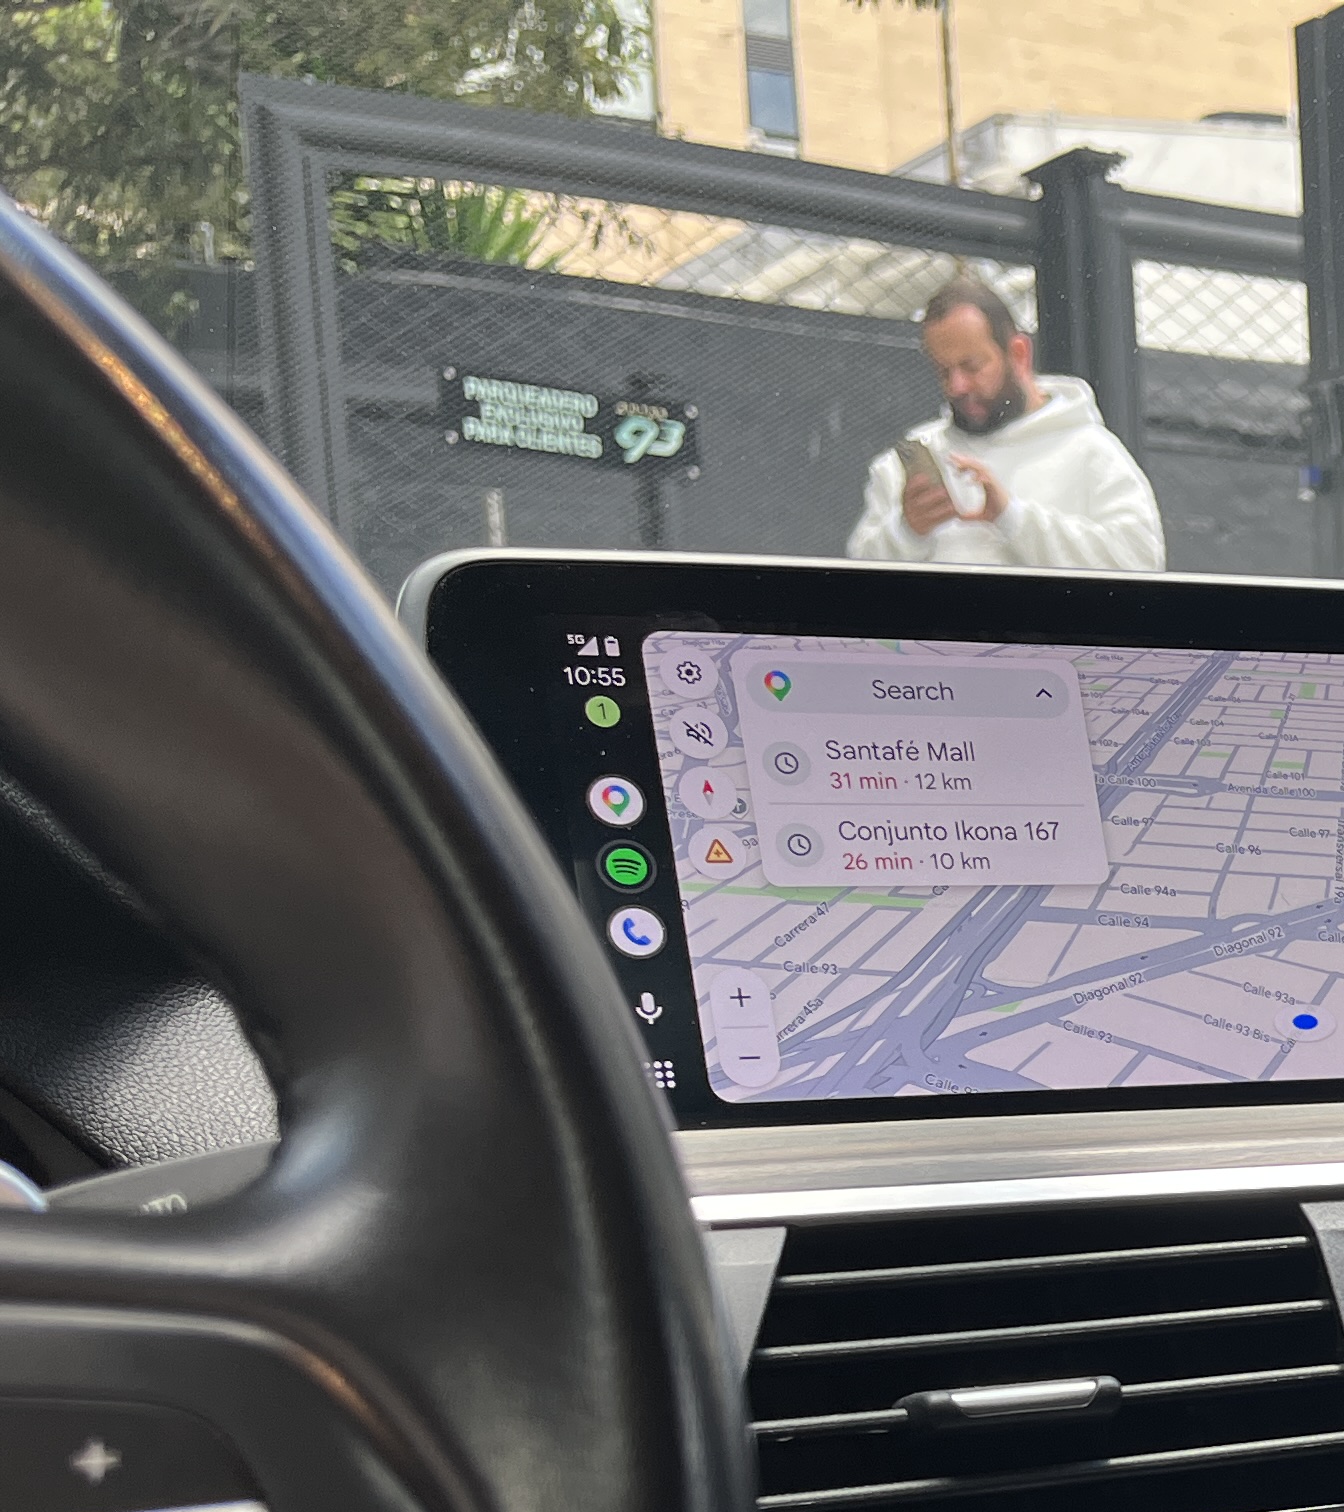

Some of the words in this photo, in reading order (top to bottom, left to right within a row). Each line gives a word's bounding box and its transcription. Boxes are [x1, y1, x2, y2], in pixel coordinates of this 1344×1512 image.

[614, 414, 686, 464] 93
[566, 633, 586, 645] 5G
[563, 666, 626, 687] 10:55
[871, 679, 954, 701] Search
[597, 703, 606, 719] 1
[825, 740, 919, 761] Santafé
[927, 741, 975, 762] Mall
[830, 772, 851, 789] 31
[860, 771, 898, 790] min
[915, 773, 937, 790] 12
[943, 772, 972, 790] km
[1108, 775, 1134, 786] Calle
[1137, 777, 1157, 788] 100
[1266, 770, 1288, 780] Calle
[1228, 783, 1268, 795] Avenida
[1271, 785, 1297, 796] Calle
[1298, 788, 1316, 797] 100
[1111, 815, 1139, 827] Calle
[1142, 817, 1155, 827] 97
[838, 820, 947, 846] Conjunto
[955, 820, 1017, 841] Ikona
[1024, 821, 1058, 841] 167
[1289, 827, 1316, 838] Calle
[1318, 829, 1330, 839] 97
[1216, 843, 1245, 855] Calle
[1248, 845, 1261, 856] 96
[843, 853, 868, 869] 26
[875, 852, 913, 869] min
[930, 853, 954, 870] 10
[961, 852, 990, 870] km
[1120, 883, 1150, 896] Calle
[1153, 885, 1177, 897] 94a
[774, 913, 816, 948] Carrera
[814, 901, 830, 918] 47
[1098, 915, 1131, 927] Calle
[1134, 916, 1149, 928] 94
[1214, 931, 1267, 957] Diagonal
[1268, 926, 1283, 940] 92
[783, 961, 818, 974] Calle
[822, 963, 838, 975] 93
[1073, 976, 1128, 1005] Diagonal
[1129, 972, 1145, 985] 92
[1243, 982, 1271, 999] Calle
[1275, 991, 1295, 1005] 93a
[803, 997, 824, 1017] 45a
[1063, 1020, 1095, 1038] Calle
[1097, 1031, 1113, 1044] 93
[1204, 1014, 1232, 1031] Calle
[1235, 1023, 1250, 1036] 93
[1252, 1029, 1270, 1043] Bis
[924, 1073, 959, 1094] Calle
